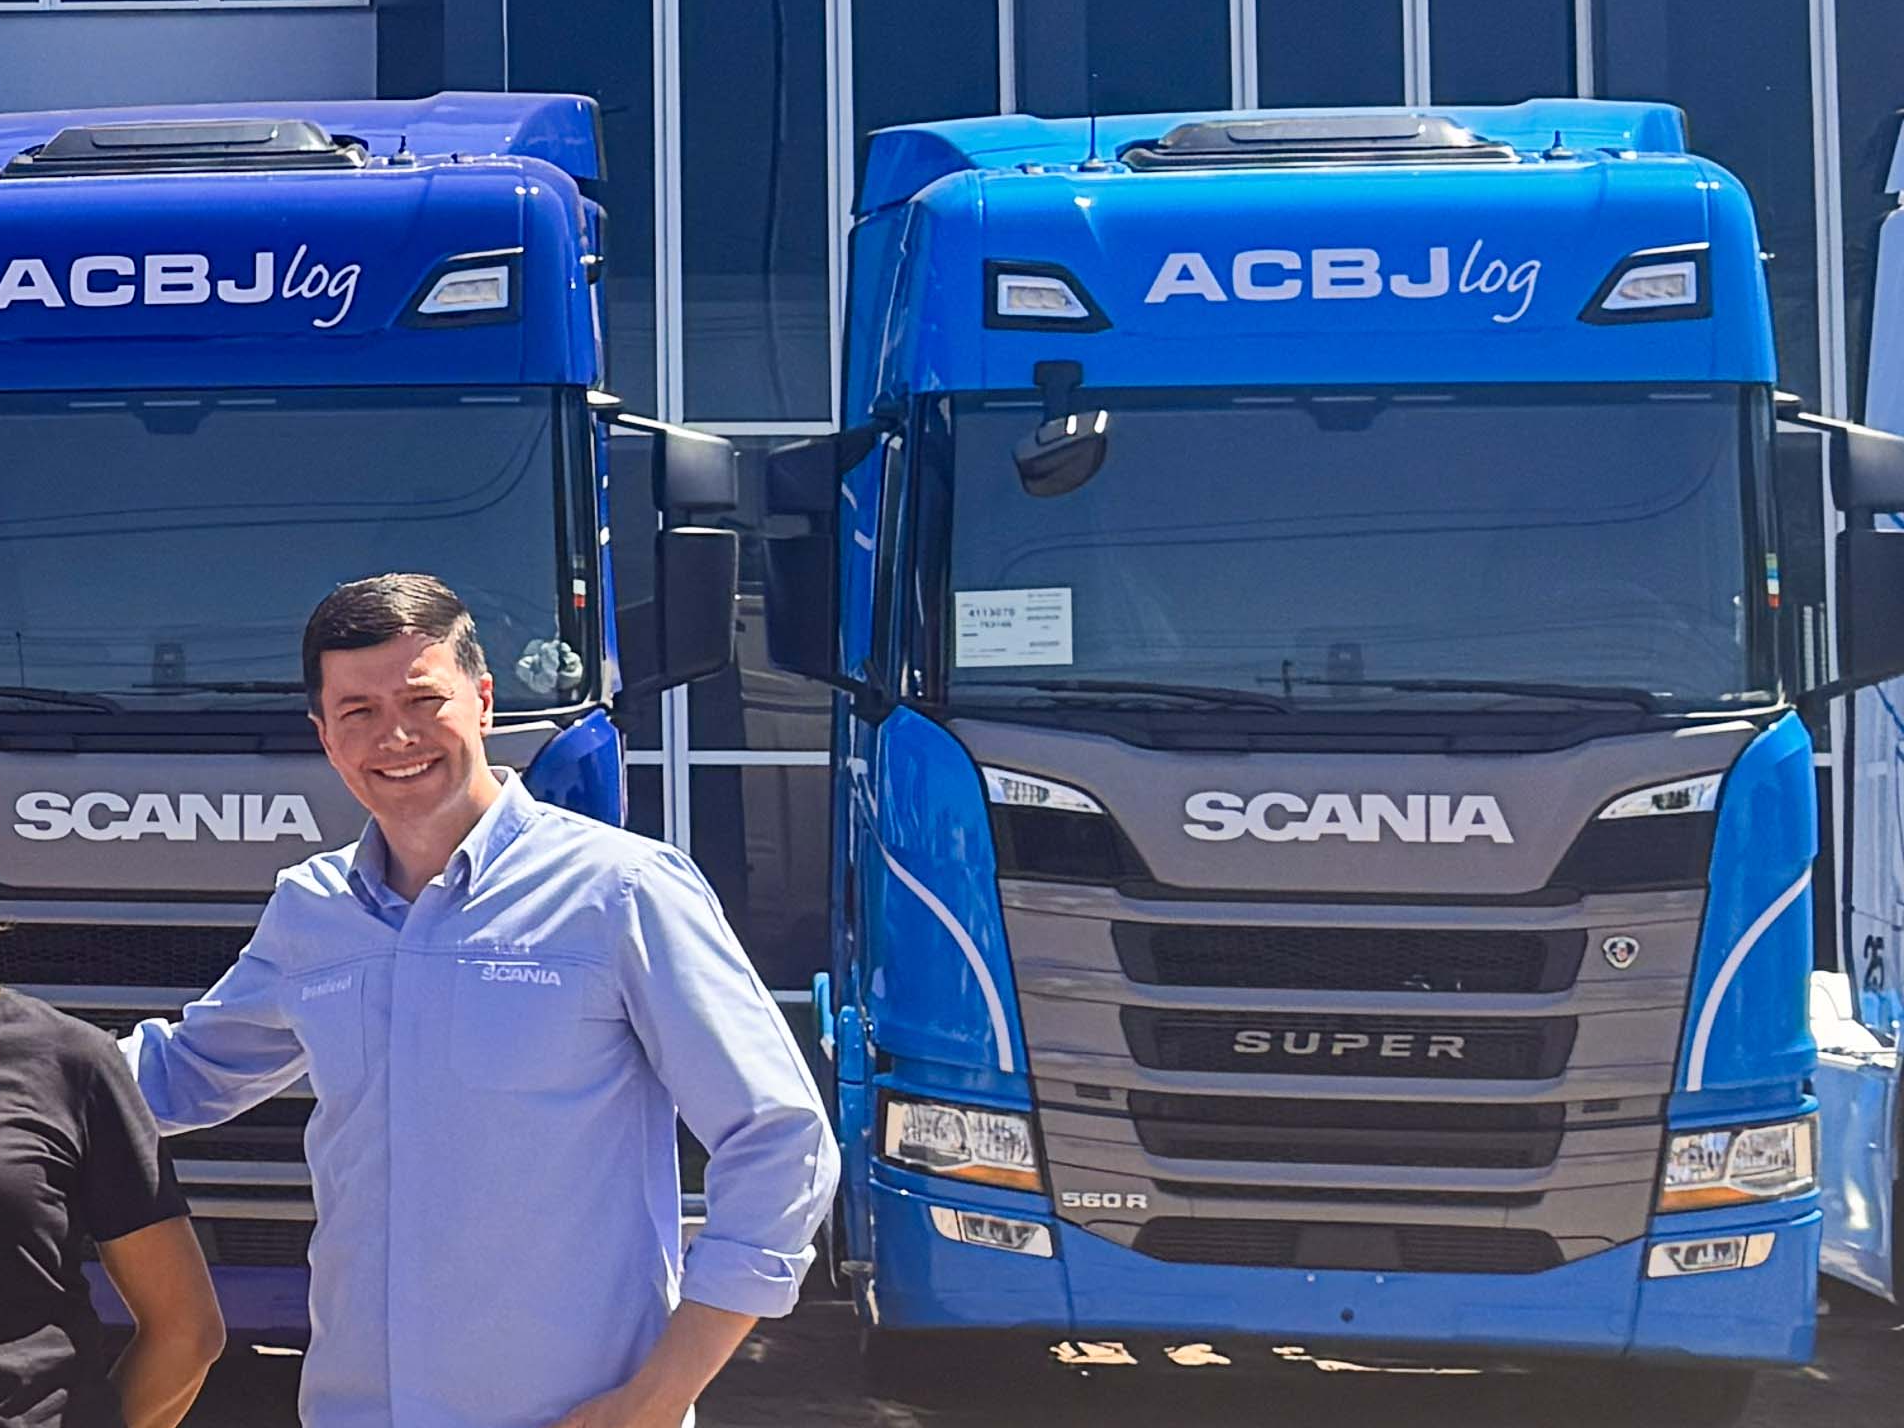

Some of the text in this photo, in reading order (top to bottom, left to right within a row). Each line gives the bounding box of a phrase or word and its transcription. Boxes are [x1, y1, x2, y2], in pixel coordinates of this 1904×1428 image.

[13, 791, 323, 842] SCANIA
[1182, 791, 1515, 843] SCANIA
[480, 966, 561, 987] SCANIA
[1233, 1030, 1466, 1059] SUPER
[1061, 1192, 1148, 1209] 560 R
